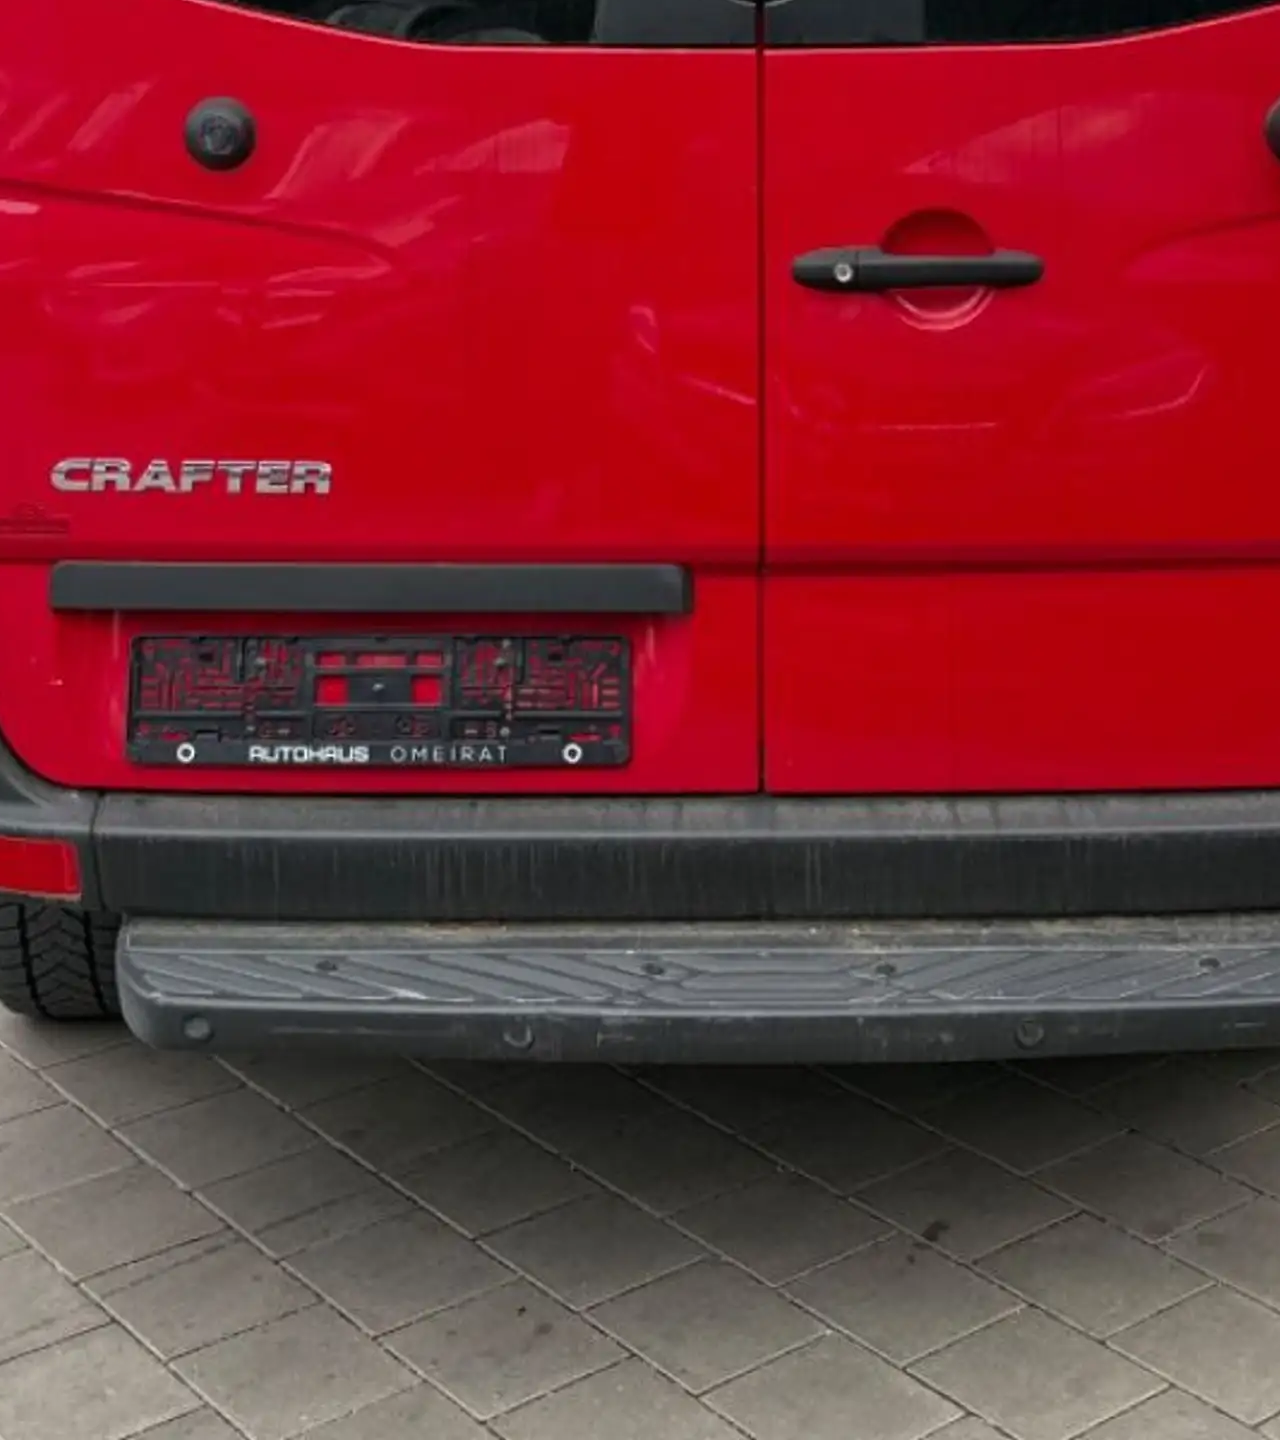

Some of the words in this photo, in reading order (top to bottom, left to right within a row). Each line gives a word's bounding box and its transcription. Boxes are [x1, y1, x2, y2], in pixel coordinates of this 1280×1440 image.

[50, 458, 332, 495] CRAFTER
[248, 745, 370, 762] AUTOHAUS
[390, 745, 508, 763] OMEIRAT
